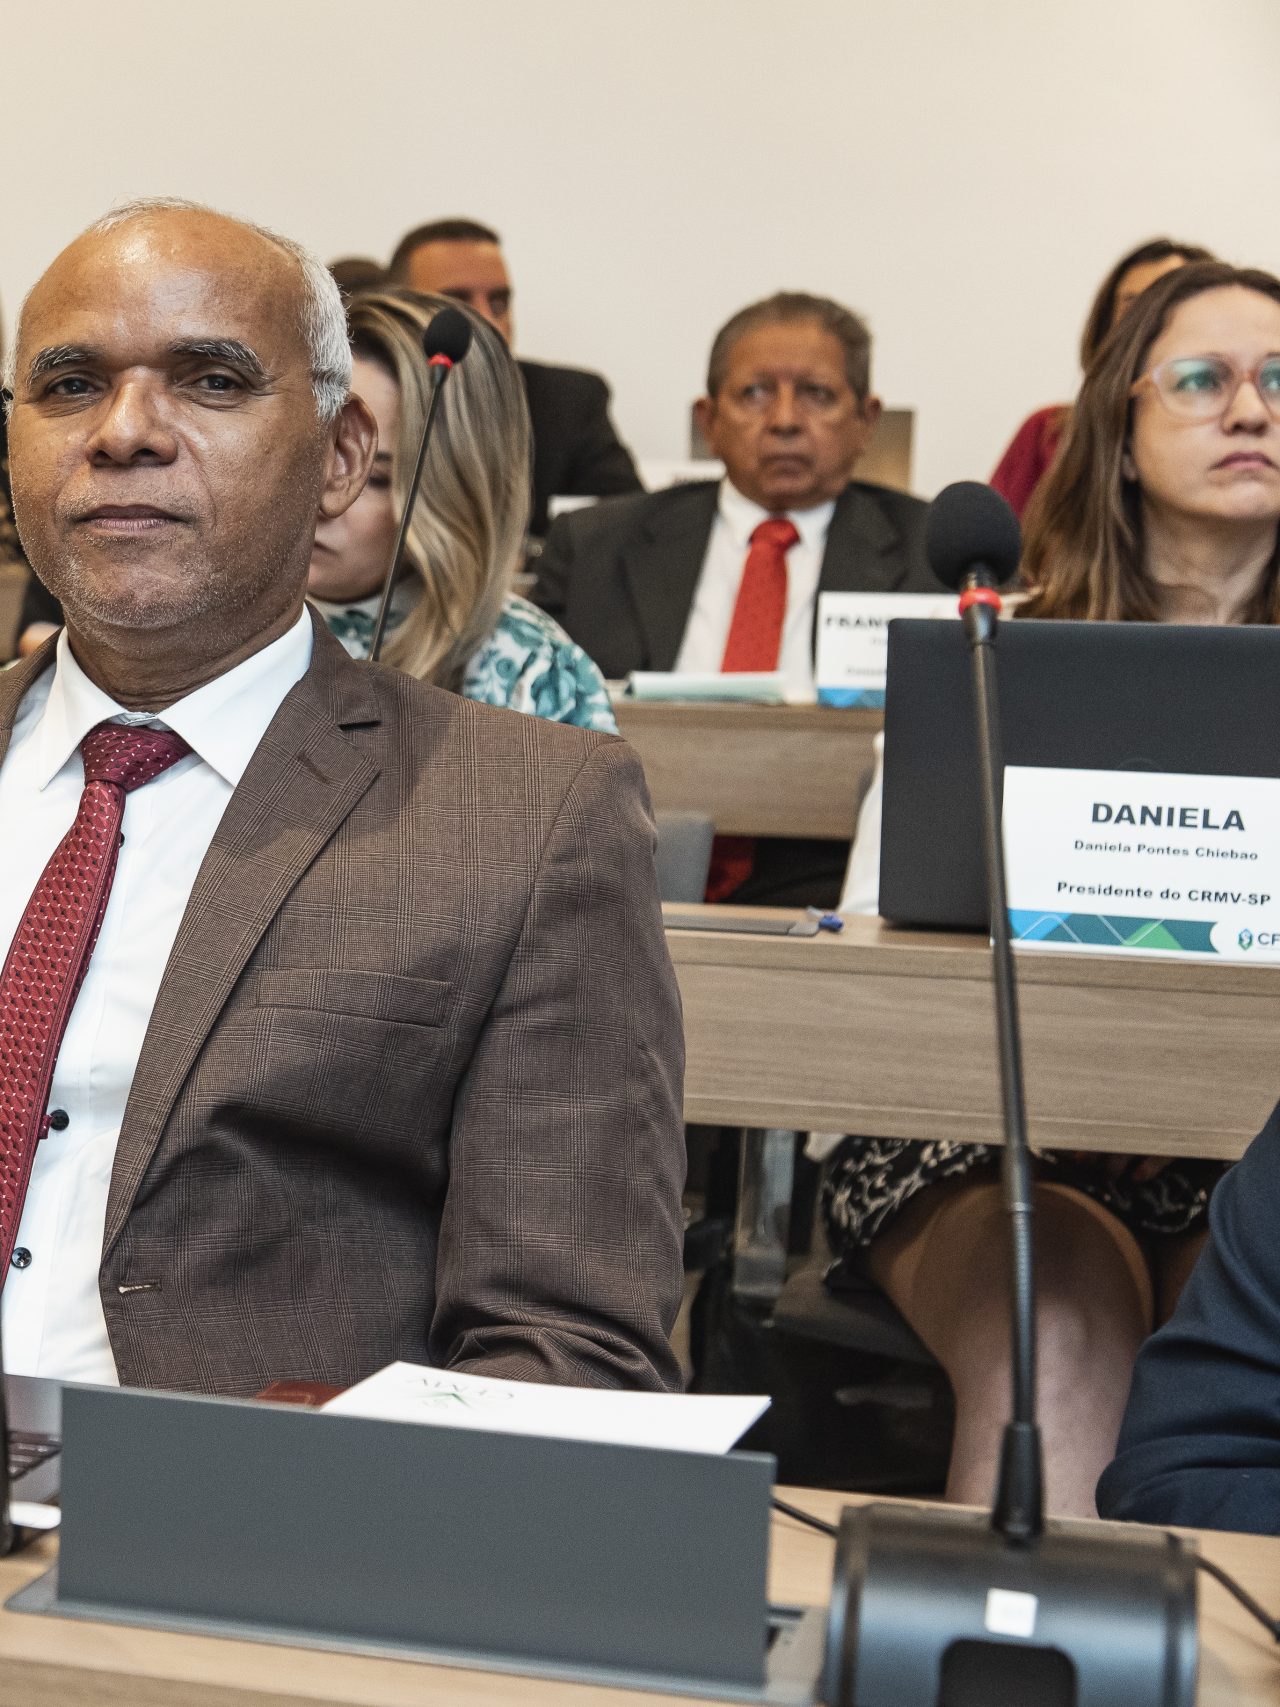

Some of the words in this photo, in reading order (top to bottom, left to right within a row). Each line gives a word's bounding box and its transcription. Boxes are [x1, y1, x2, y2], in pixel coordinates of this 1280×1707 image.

[825, 615, 887, 629] FRAN
[1091, 802, 1246, 832] DANIELA
[1074, 839, 1131, 854] Daniela
[1137, 843, 1189, 857] Pontes
[1195, 847, 1259, 862] Chiebao
[1057, 881, 1153, 899] Presidente
[1159, 888, 1181, 901] do
[1187, 889, 1272, 907] CRMV-SP
